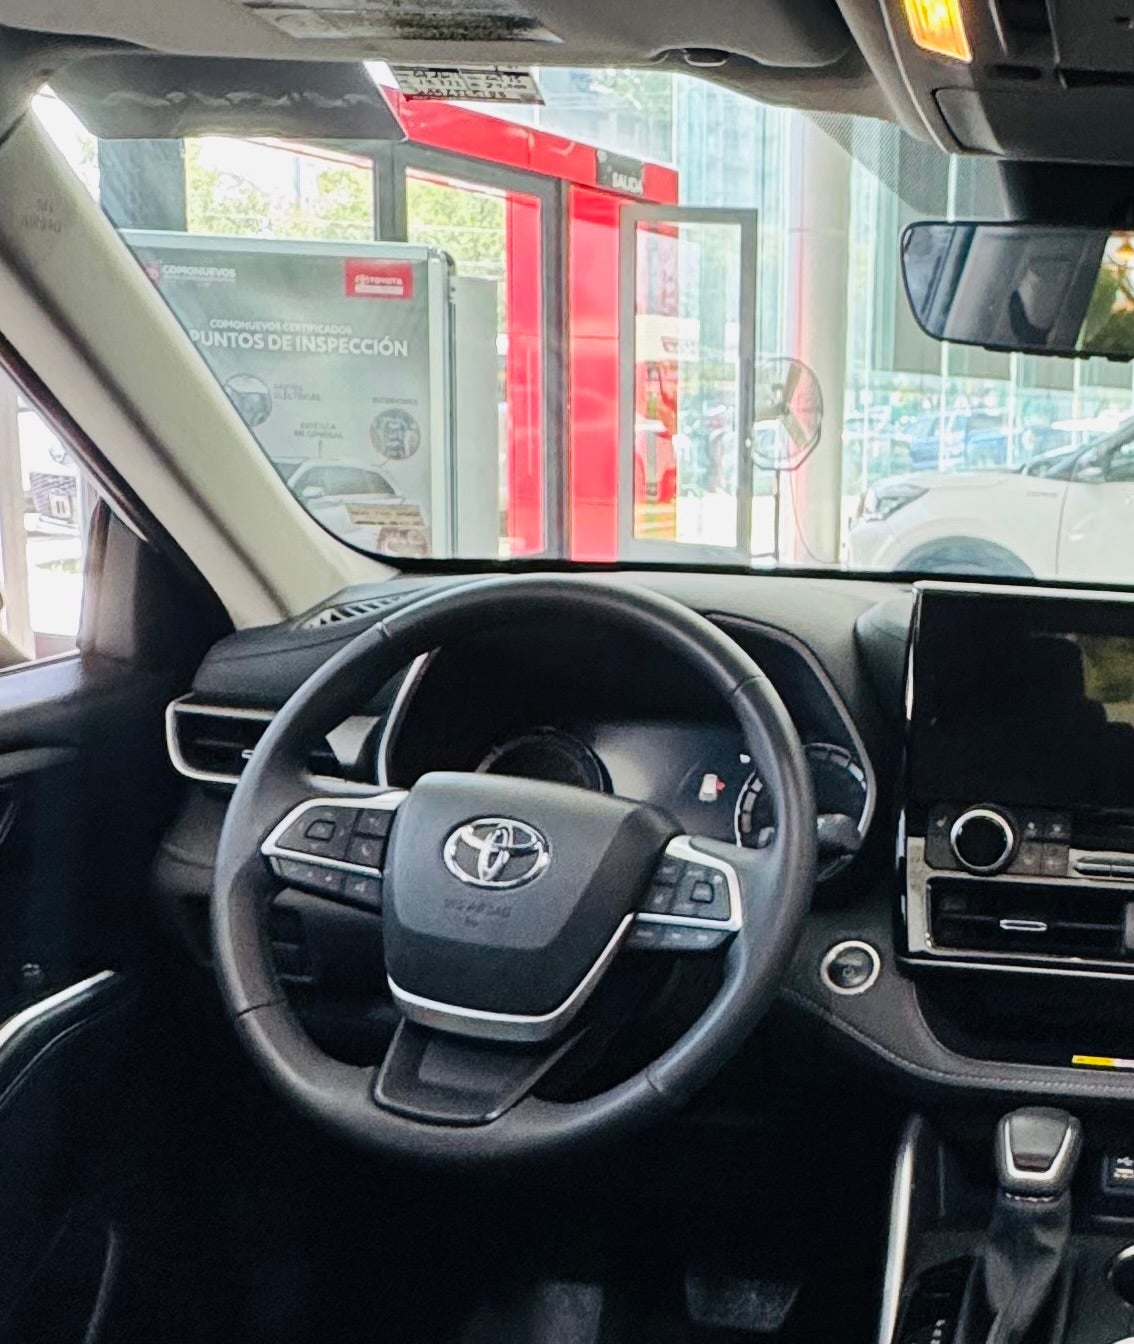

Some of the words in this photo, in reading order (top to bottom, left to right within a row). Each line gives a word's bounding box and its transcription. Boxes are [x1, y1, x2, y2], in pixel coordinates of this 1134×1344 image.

[209, 318, 281, 332] COMONUEVOS
[282, 321, 352, 336] CERTIFICADOS
[267, 333, 292, 352] DE
[295, 334, 409, 357] INSPECCIÓN
